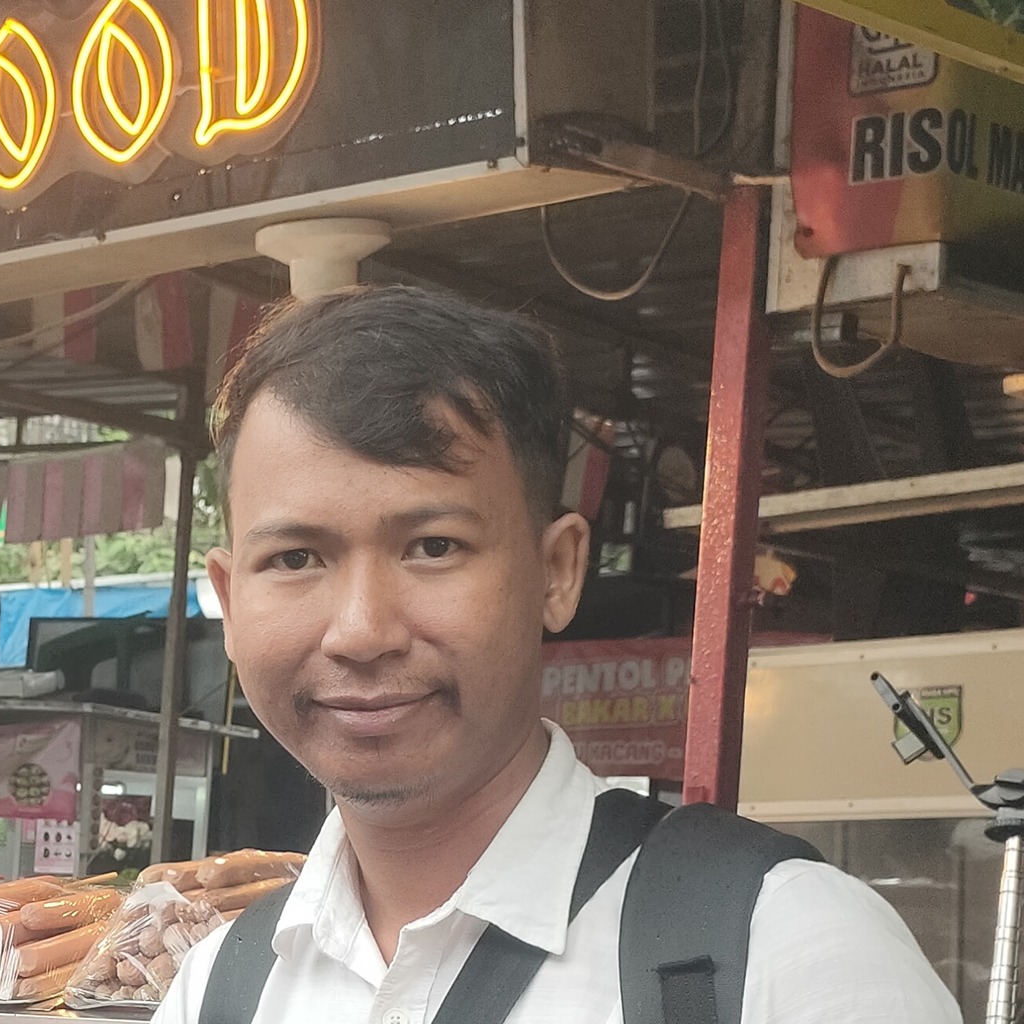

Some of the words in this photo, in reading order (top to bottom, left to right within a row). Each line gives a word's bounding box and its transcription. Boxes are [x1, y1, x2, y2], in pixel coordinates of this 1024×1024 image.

[858, 53, 922, 79] HALAL
[851, 107, 978, 183] RISOL
[542, 659, 656, 696] PENTOL
[665, 656, 690, 687] P
